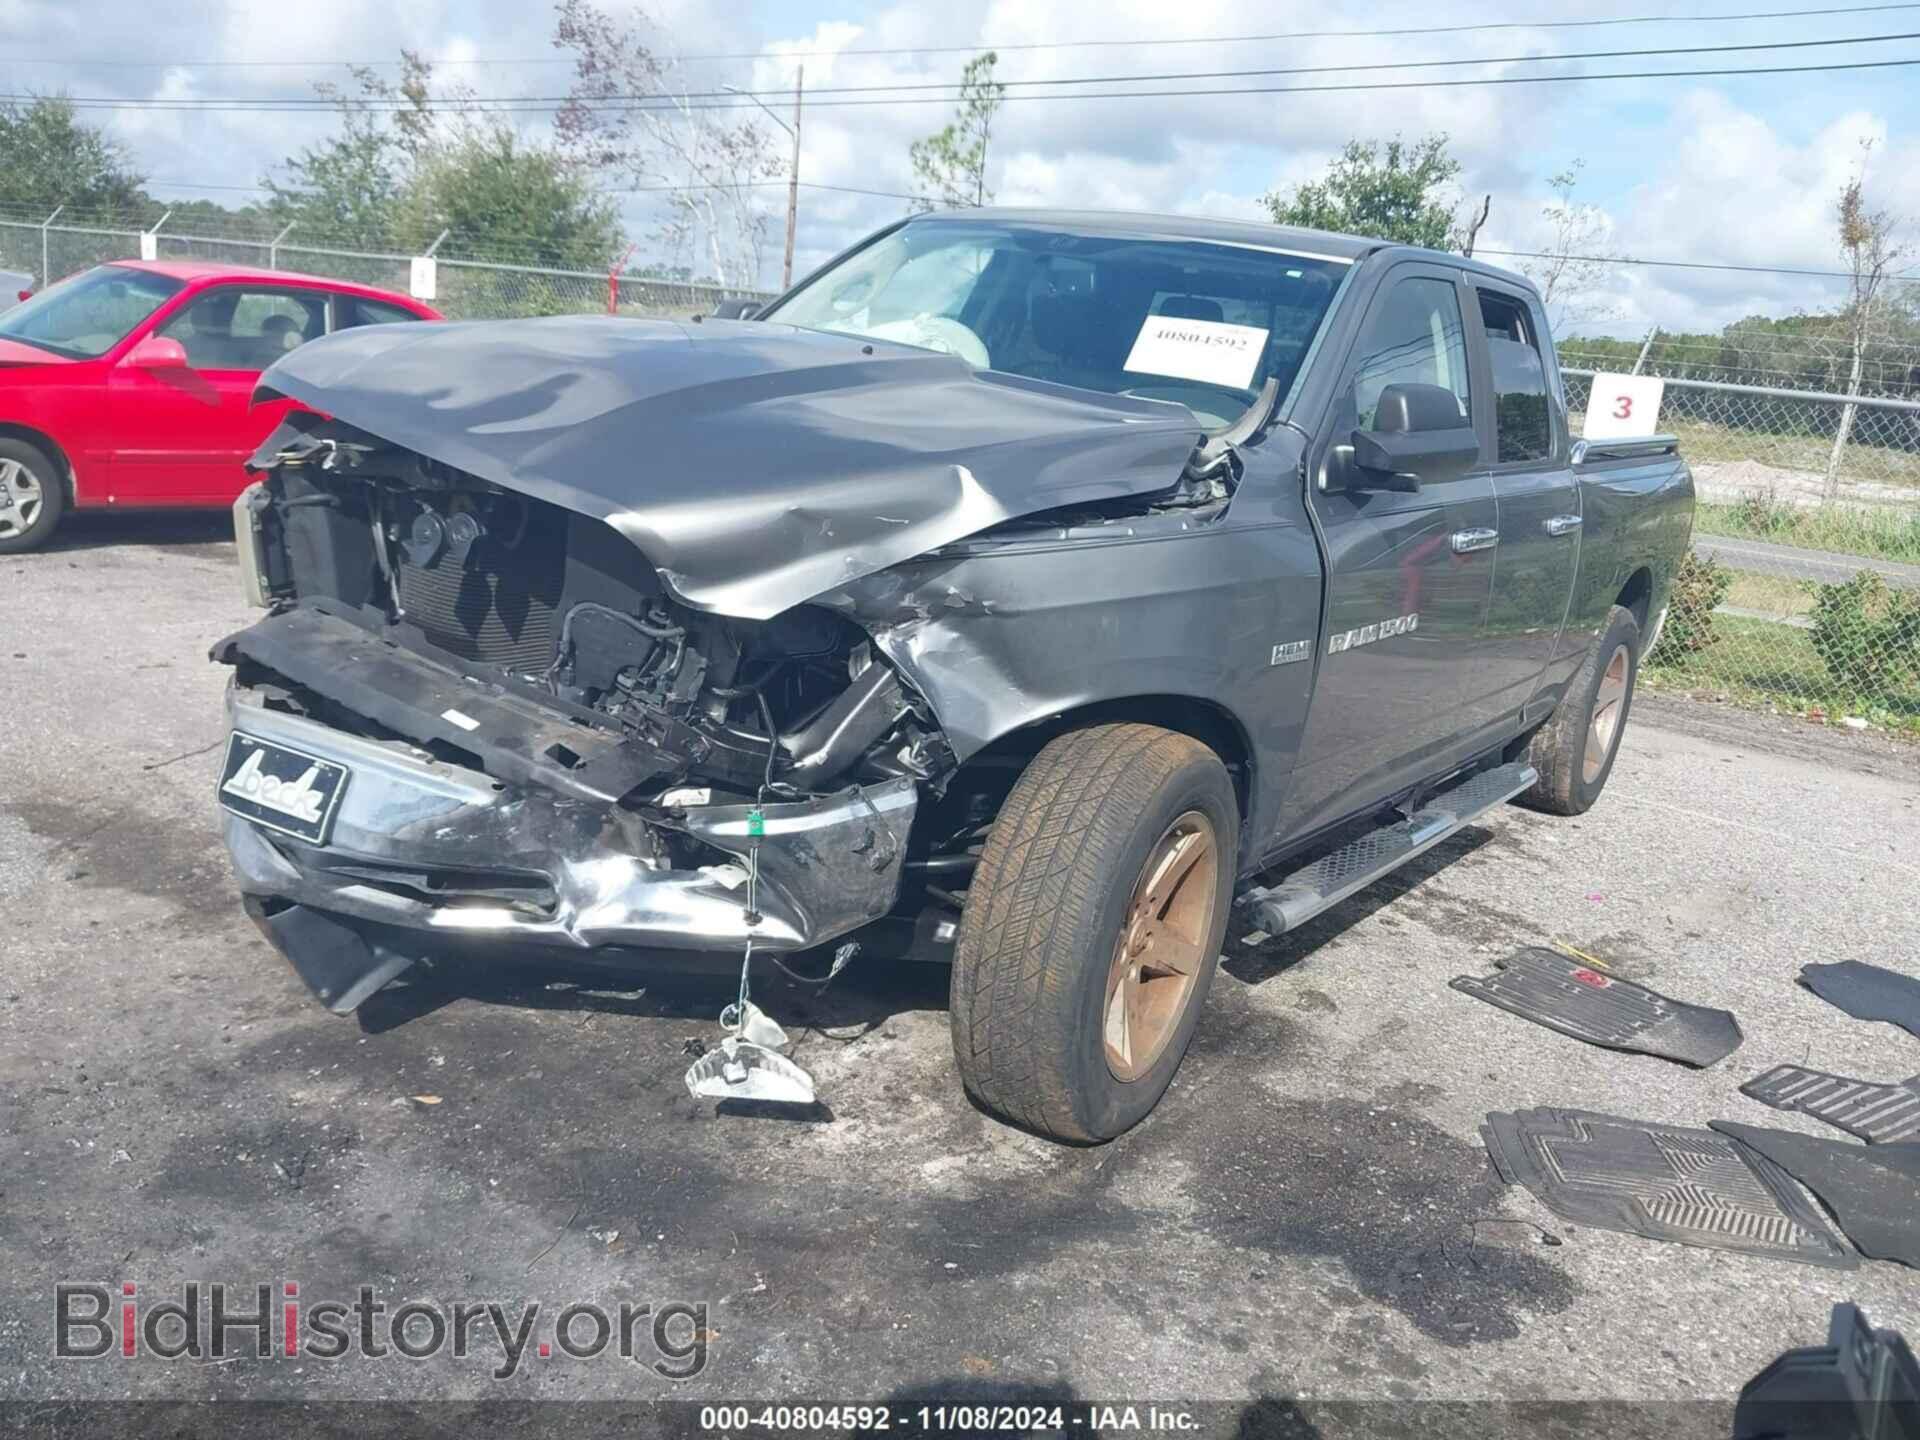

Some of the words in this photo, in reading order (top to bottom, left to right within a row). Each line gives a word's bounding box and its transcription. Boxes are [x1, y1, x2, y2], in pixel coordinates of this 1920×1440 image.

[1154, 329, 1248, 351] 40804592
[1613, 396, 1632, 419] 3
[1328, 623, 1378, 655] RAM
[1379, 612, 1419, 640] 1500
